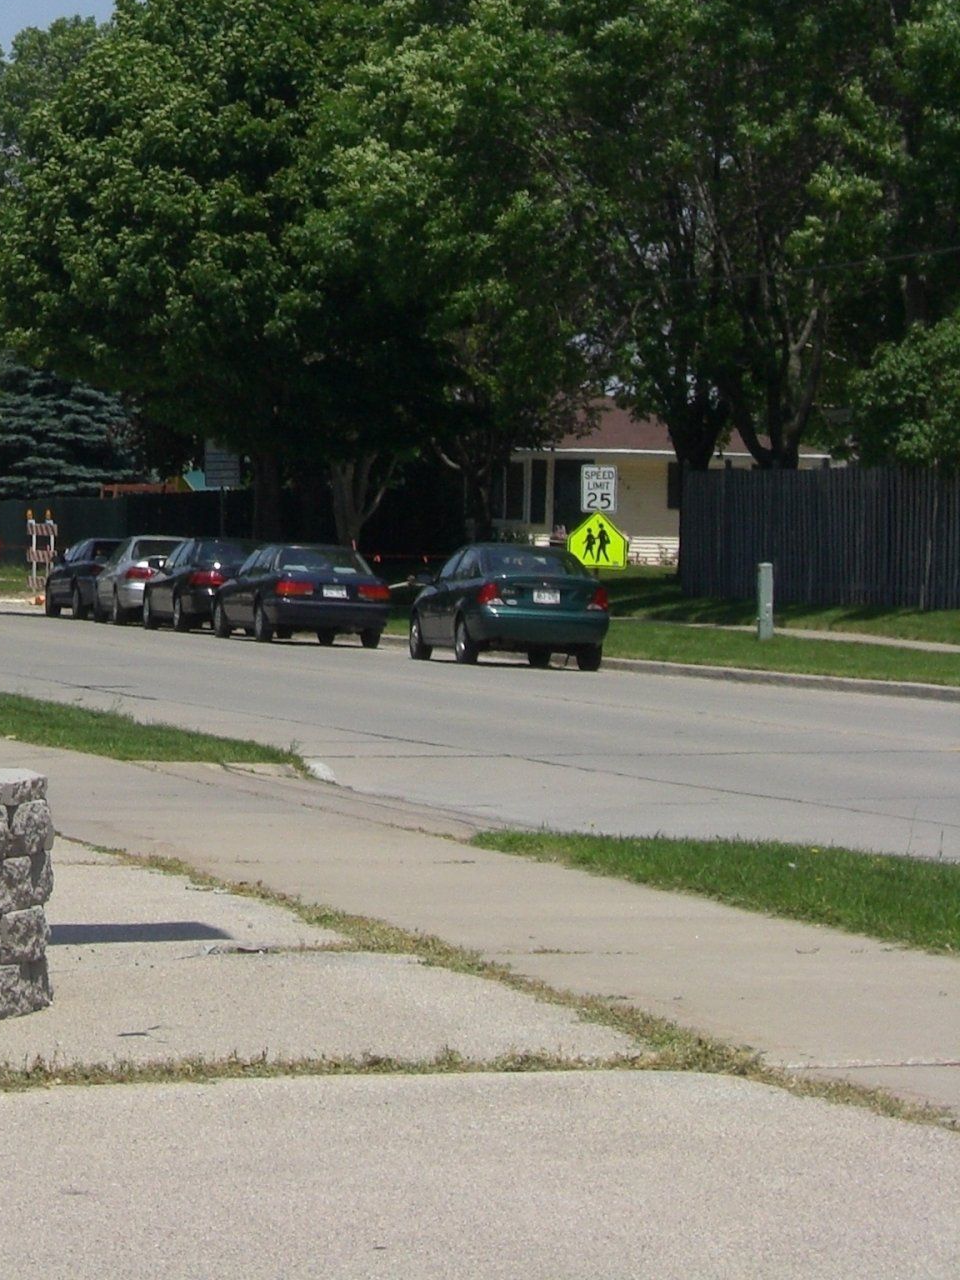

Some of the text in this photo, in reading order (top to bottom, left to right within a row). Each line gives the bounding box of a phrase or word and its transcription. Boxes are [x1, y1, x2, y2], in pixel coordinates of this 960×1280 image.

[584, 470, 614, 480] SPEED
[587, 481, 610, 490] LIMIT
[586, 492, 611, 509] 25
